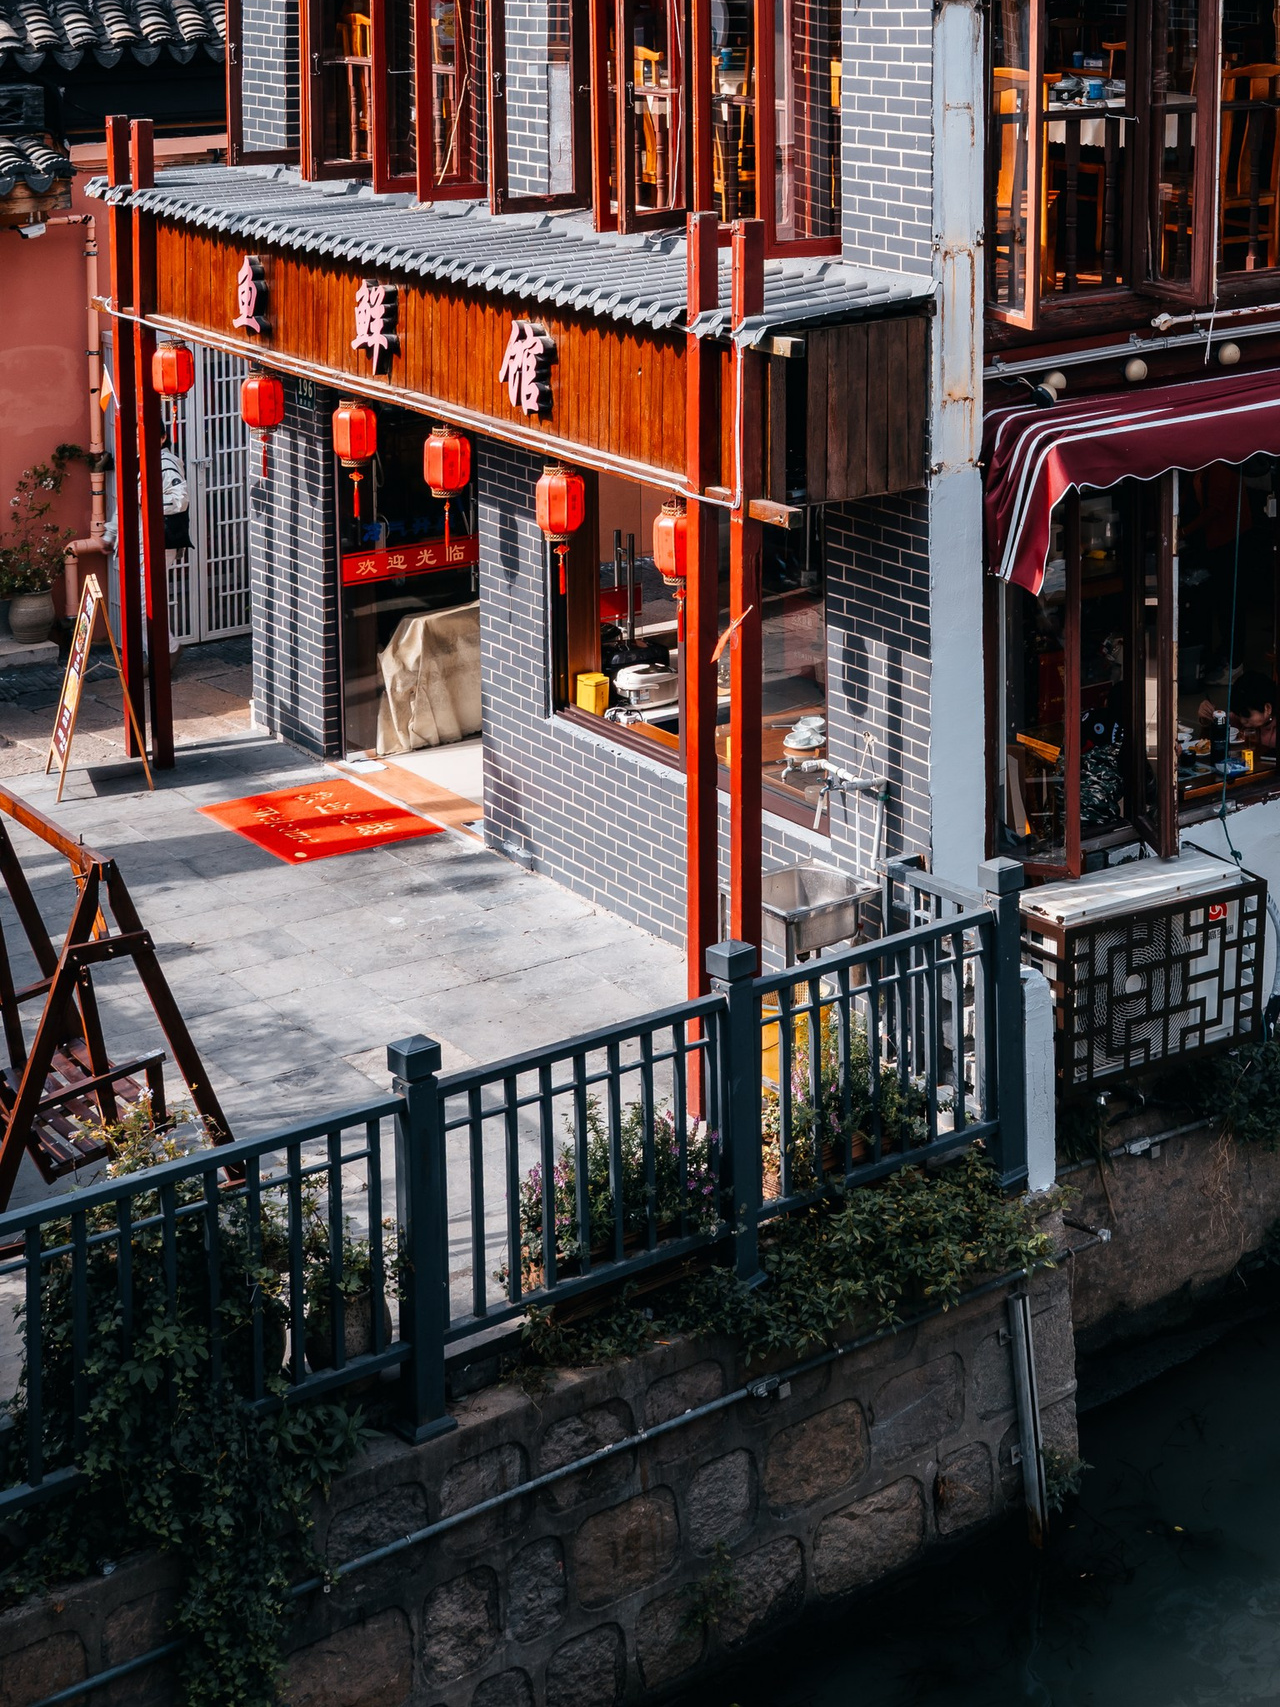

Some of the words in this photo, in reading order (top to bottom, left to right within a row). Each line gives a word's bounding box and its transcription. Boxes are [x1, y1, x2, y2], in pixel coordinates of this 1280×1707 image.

[232, 255, 544, 416] 鱼鲜馆
[298, 378, 313, 398] 196
[355, 544, 466, 575] 欢迎光临
